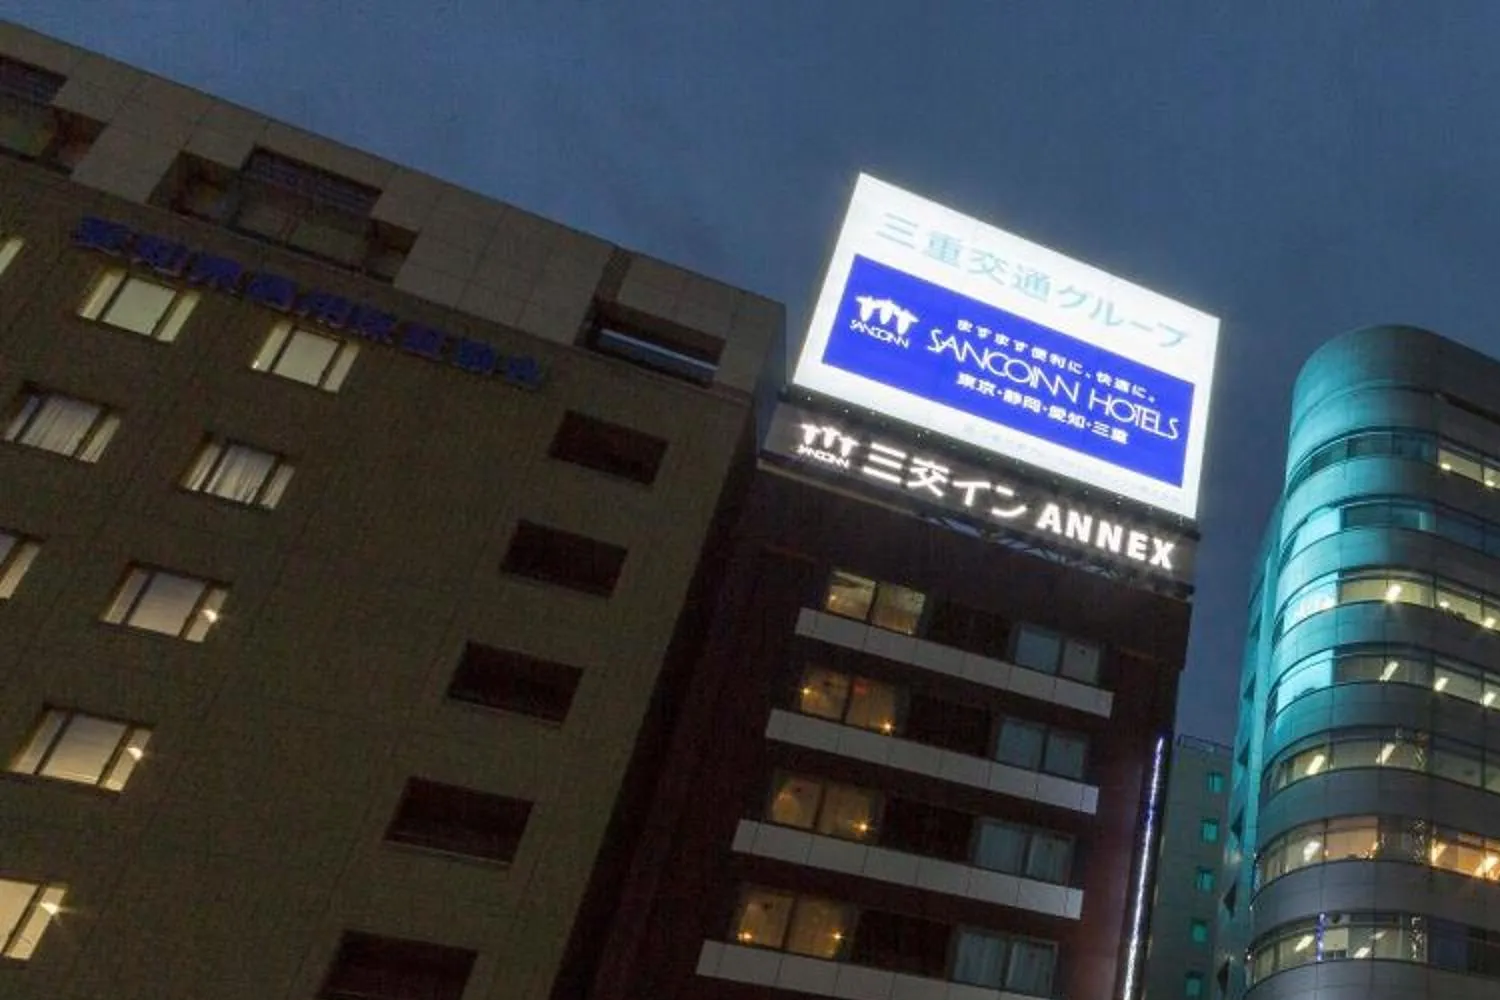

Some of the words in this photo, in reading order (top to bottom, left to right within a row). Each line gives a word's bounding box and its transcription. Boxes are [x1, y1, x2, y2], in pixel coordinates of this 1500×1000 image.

[876, 212, 1190, 350] 三重交通グループ
[927, 328, 1082, 403] SANCOINN
[1089, 389, 1179, 440] HOTELS
[862, 441, 1028, 518] 三交イン
[1036, 503, 1175, 570] ANNEX
